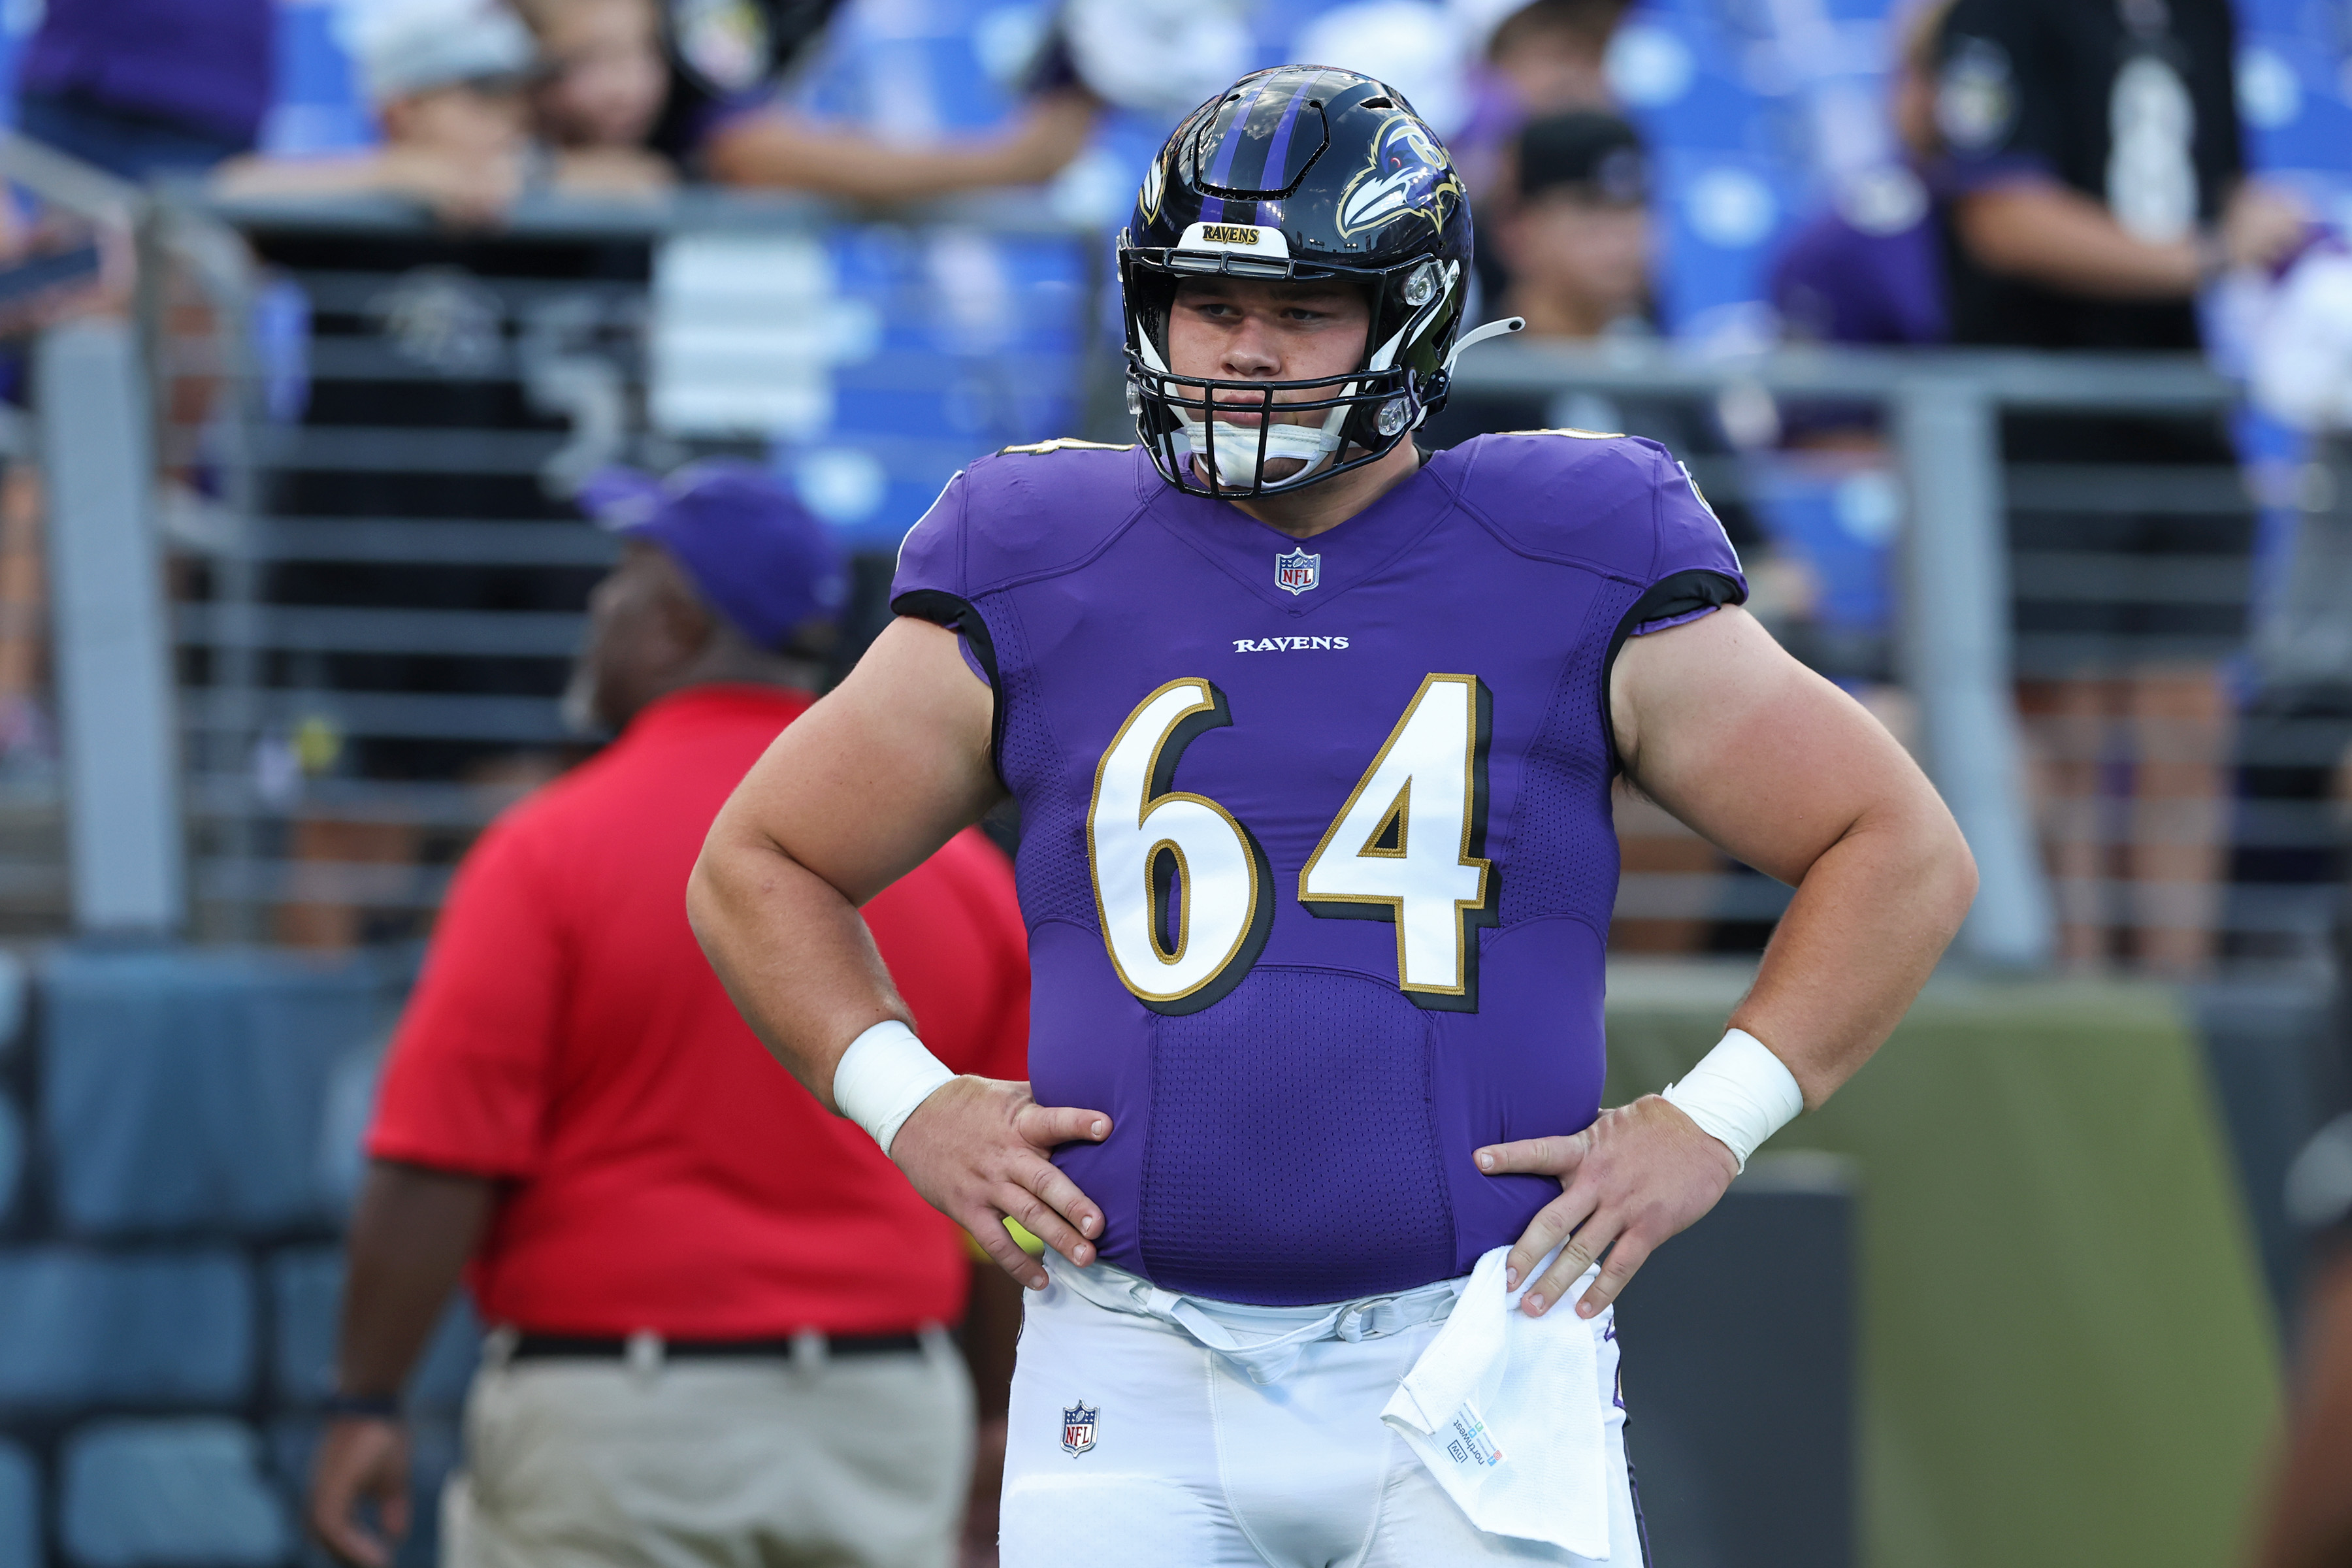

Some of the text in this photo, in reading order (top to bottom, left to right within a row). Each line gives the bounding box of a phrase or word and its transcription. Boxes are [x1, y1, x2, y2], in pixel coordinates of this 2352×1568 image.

[1203, 225, 1260, 245] RAVENS
[1282, 569, 1312, 586] NFL
[1232, 636, 1350, 653] RAVENS
[1086, 672, 1504, 1017] 64
[1065, 1426, 1090, 1446] NFL
[1452, 1419, 1485, 1465] northwest
